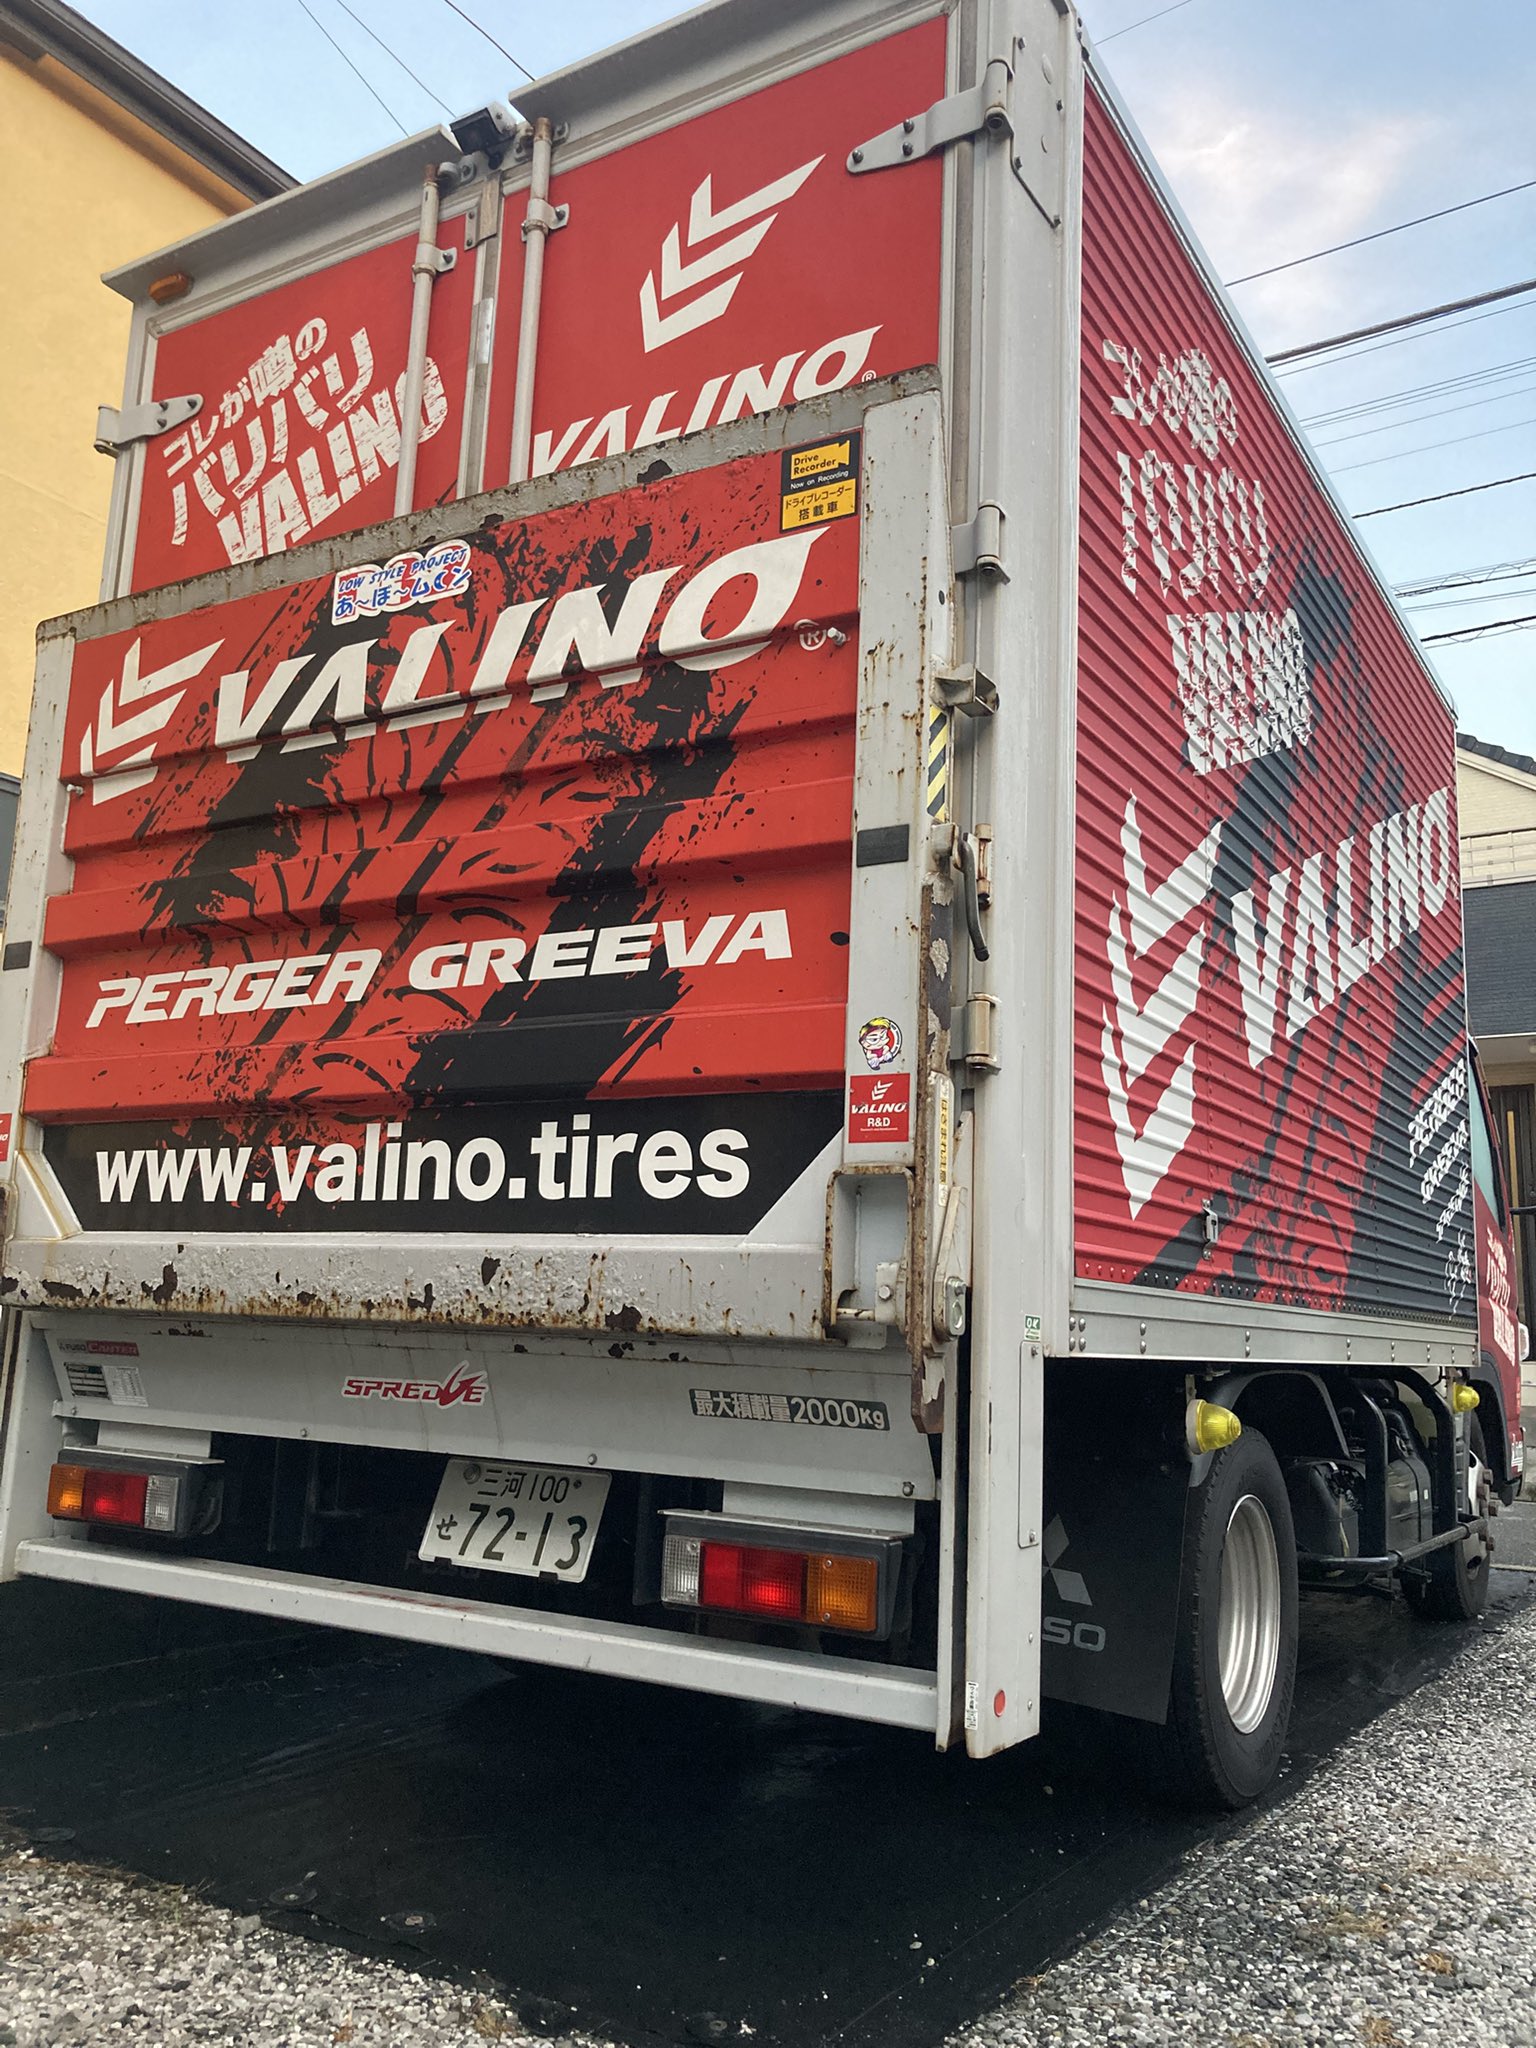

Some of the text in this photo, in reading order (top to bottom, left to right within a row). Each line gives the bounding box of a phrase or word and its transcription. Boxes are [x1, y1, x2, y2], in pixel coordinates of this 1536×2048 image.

[532, 325, 884, 478] VALINO
[216, 356, 448, 565] VALINO
[793, 453, 819, 467] Drive
[793, 459, 837, 475] Recorder
[790, 481, 805, 490] Now
[817, 470, 850, 484] Recording
[785, 487, 853, 510] ドライブレコーダー
[798, 501, 839, 522] 搭載車
[338, 548, 468, 592] LOW STYLE PROJECT
[215, 526, 831, 764] VALINO
[1231, 787, 1453, 1070] VALINO
[85, 909, 793, 1029] PERGEA GREEVA
[851, 1102, 904, 1114] VALINO
[867, 1117, 891, 1127] R&D
[96, 1114, 750, 1202] www.valino.tires
[1026, 1317, 1039, 1328] OK
[436, 1514, 458, 1540] せ
[458, 1502, 588, 1570] 72-13
[1042, 1616, 1106, 1652] SO
